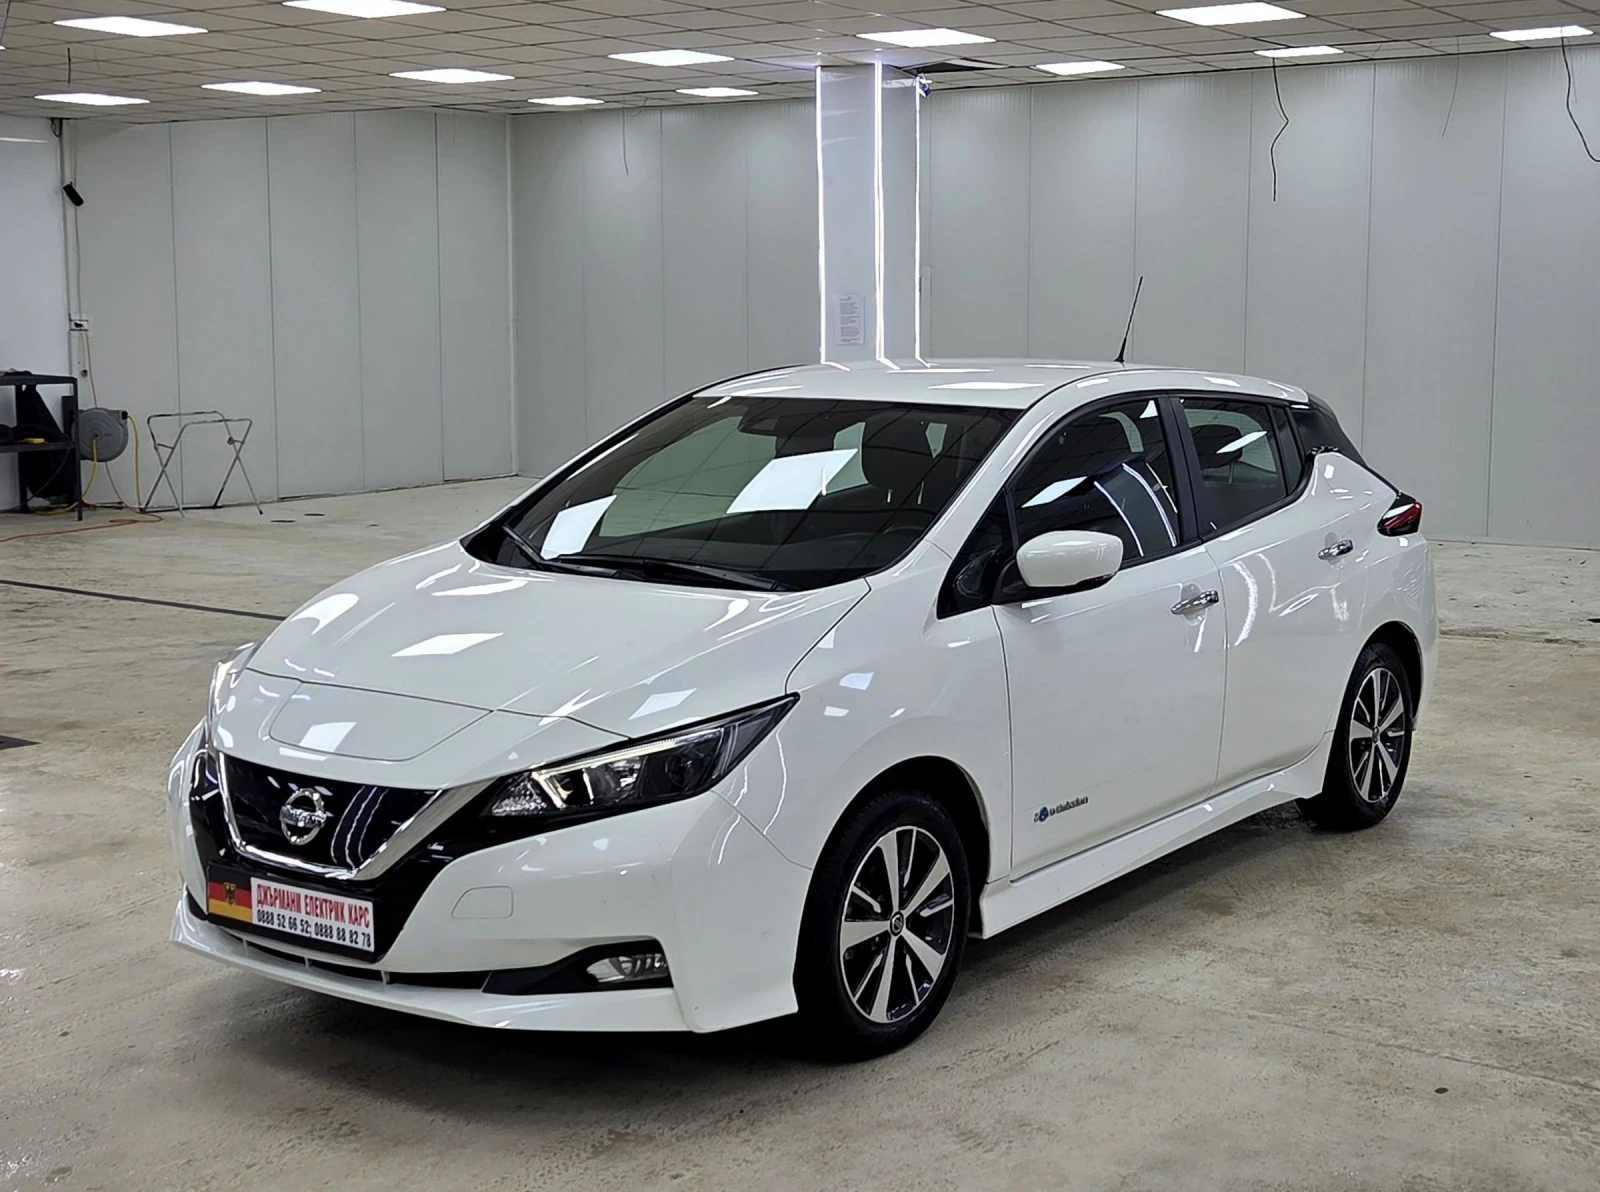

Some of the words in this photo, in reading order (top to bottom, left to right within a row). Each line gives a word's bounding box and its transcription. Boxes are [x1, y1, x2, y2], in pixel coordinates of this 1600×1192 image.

[257, 884, 302, 913] ДЖЪРМАНИ
[304, 894, 346, 924] ЕЛЕКТРИК
[348, 903, 370, 928] КАРС
[257, 909, 275, 925] 0888
[277, 913, 286, 928] 52
[288, 916, 298, 931] 66
[314, 922, 333, 939] 0888
[336, 926, 346, 942] 88
[349, 929, 359, 944] 82
[361, 932, 371, 948] 78
